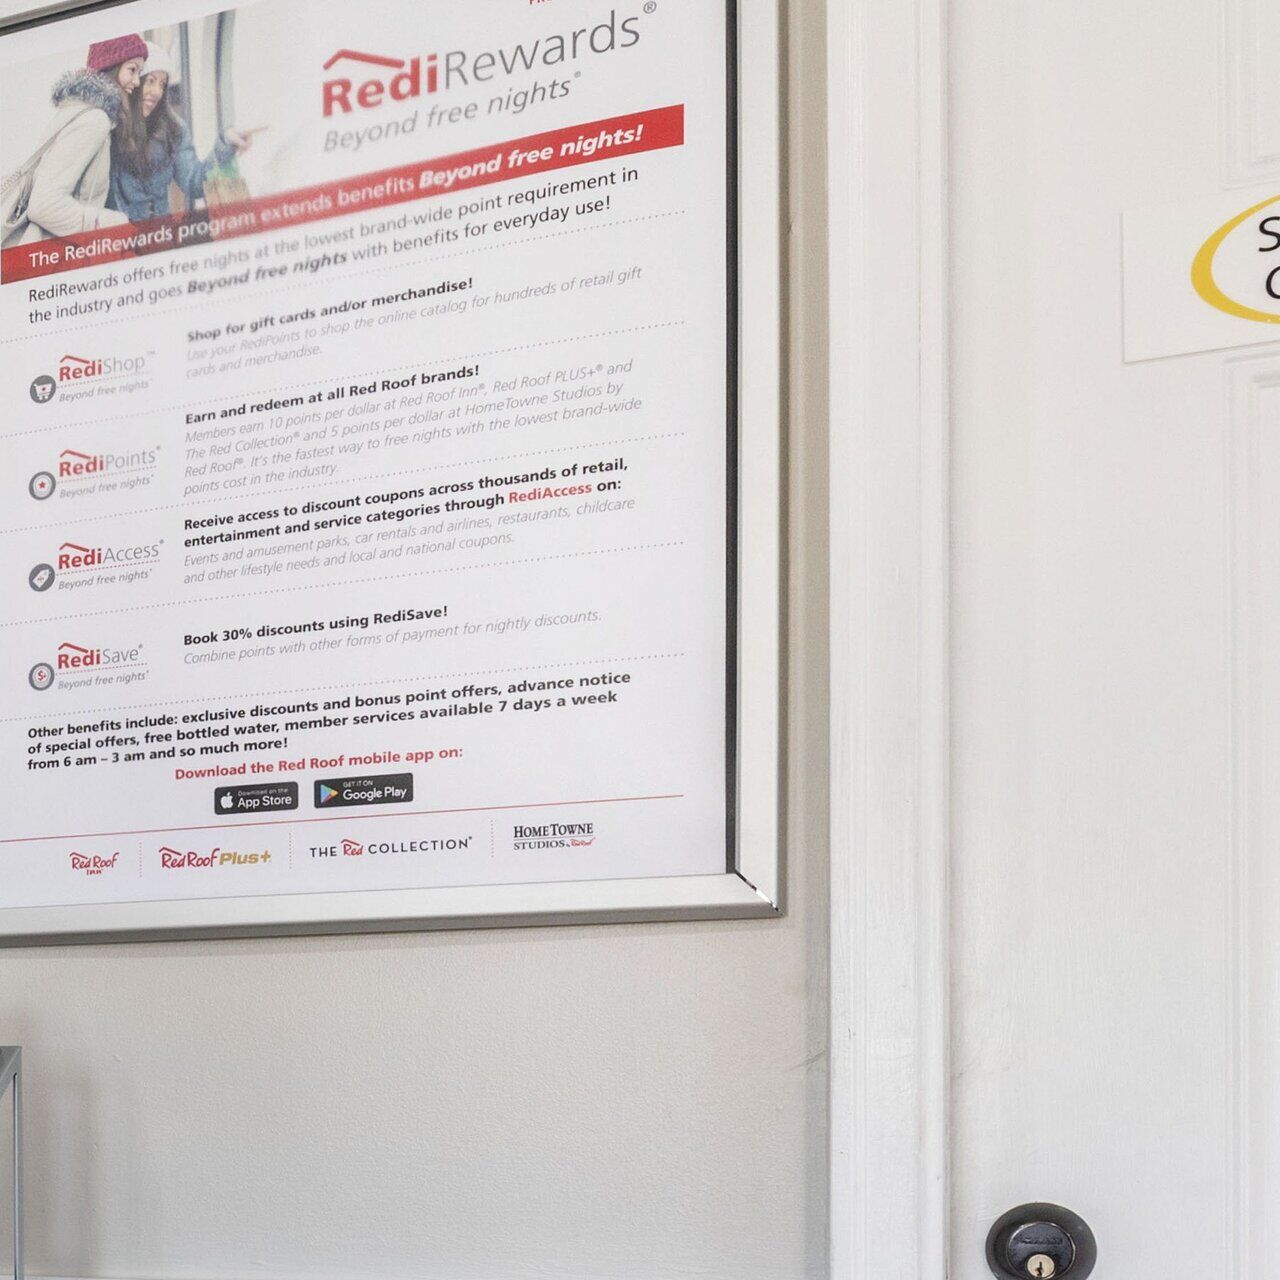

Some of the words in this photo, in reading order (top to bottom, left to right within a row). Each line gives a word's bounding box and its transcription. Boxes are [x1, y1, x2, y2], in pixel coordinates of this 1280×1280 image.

[324, 113, 417, 152] Beyond
[428, 102, 477, 128] free
[28, 251, 59, 267] The
[65, 225, 173, 261] RediRewards
[178, 212, 256, 242] program
[260, 193, 332, 221] extends
[337, 177, 414, 205] benefits
[419, 153, 502, 189] Beyond
[508, 147, 553, 168] free
[560, 124, 643, 156] nights!
[29, 273, 118, 302] RediRewards
[123, 266, 164, 283] offers
[169, 260, 198, 274] free
[203, 250, 250, 270] nights
[254, 244, 269, 259] at
[274, 239, 299, 255] the
[304, 227, 354, 249] lowest
[360, 206, 452, 237] brand-wide
[458, 195, 502, 219] point
[508, 172, 616, 208] requirement
[623, 167, 637, 182] in
[29, 309, 51, 323] the
[56, 299, 112, 318] industry
[117, 289, 143, 307] and
[148, 286, 182, 304] goes
[187, 266, 250, 294] Beyond
[255, 265, 288, 280] free
[293, 252, 346, 273] nights
[352, 242, 387, 260] with
[393, 229, 458, 252] benefits
[464, 223, 488, 237] for
[493, 206, 569, 231] everyday
[576, 195, 609, 215] use!
[188, 329, 221, 342] Shop
[226, 324, 245, 334] for
[250, 316, 274, 332] gift
[279, 308, 315, 324] cards
[320, 300, 366, 316] and/or
[372, 277, 472, 306] merchandise!
[186, 412, 215, 424] Earn
[220, 403, 245, 418] and
[250, 397, 303, 413] redeem
[308, 392, 322, 403] at
[327, 387, 344, 400] all
[349, 381, 376, 396] Red
[382, 374, 416, 391] Roof
[421, 365, 478, 384] brands!
[184, 514, 233, 530] Receive
[238, 509, 279, 522] access
[283, 506, 297, 516] to
[302, 495, 360, 513] discount
[365, 488, 424, 504] coupons
[429, 481, 474, 495] across
[478, 467, 556, 488] thousands
[561, 463, 577, 477] of
[583, 457, 627, 474] retail,
[184, 525, 280, 547] entertainment
[284, 520, 309, 534] and
[314, 514, 361, 530] service
[366, 504, 440, 522] categories
[445, 493, 504, 512] through
[509, 484, 591, 503] RediAccess
[597, 480, 620, 491] on:
[184, 631, 218, 645] Book
[222, 628, 252, 641] 30%
[256, 621, 324, 637] discounts
[329, 616, 368, 629] using
[374, 605, 446, 624] RediSave!
[28, 726, 63, 738] Other
[67, 720, 121, 734] benefits
[126, 714, 177, 728] include:
[182, 708, 245, 723] exclusive
[250, 701, 318, 717] discounts
[323, 697, 350, 710] and
[355, 695, 400, 707] bonus
[406, 689, 446, 705] point
[451, 684, 501, 698] offers,
[507, 679, 574, 693] advance
[580, 672, 630, 686] notice
[28, 742, 41, 754] of
[45, 738, 90, 754] special
[95, 735, 139, 747] offers,
[144, 732, 172, 743] free
[177, 725, 229, 740] bottled
[234, 723, 279, 735] water,
[285, 716, 348, 730] member
[353, 710, 414, 724] services
[420, 702, 492, 718] available
[499, 700, 507, 711] 7
[513, 698, 551, 711] days
[556, 698, 565, 706] a
[571, 690, 617, 705] week
[27, 753, 59, 769] from
[63, 756, 71, 766] 6
[75, 756, 96, 765] am
[112, 752, 119, 762] 3
[124, 752, 144, 761] am
[149, 746, 175, 759] and
[180, 747, 195, 756] so
[200, 741, 238, 755] much
[244, 737, 287, 751] more!
[175, 763, 245, 779] Download
[250, 762, 273, 773] the
[279, 758, 305, 771] Red
[310, 754, 344, 768] Roof
[349, 751, 400, 765] mobile
[405, 751, 434, 763] app
[439, 748, 462, 758] on:
[238, 797, 259, 809] App
[262, 795, 292, 806] Store
[343, 788, 382, 801] Google
[385, 787, 407, 799] Play
[310, 846, 337, 858] THE
[343, 841, 363, 856] Red
[514, 840, 565, 850] STUDIOS
